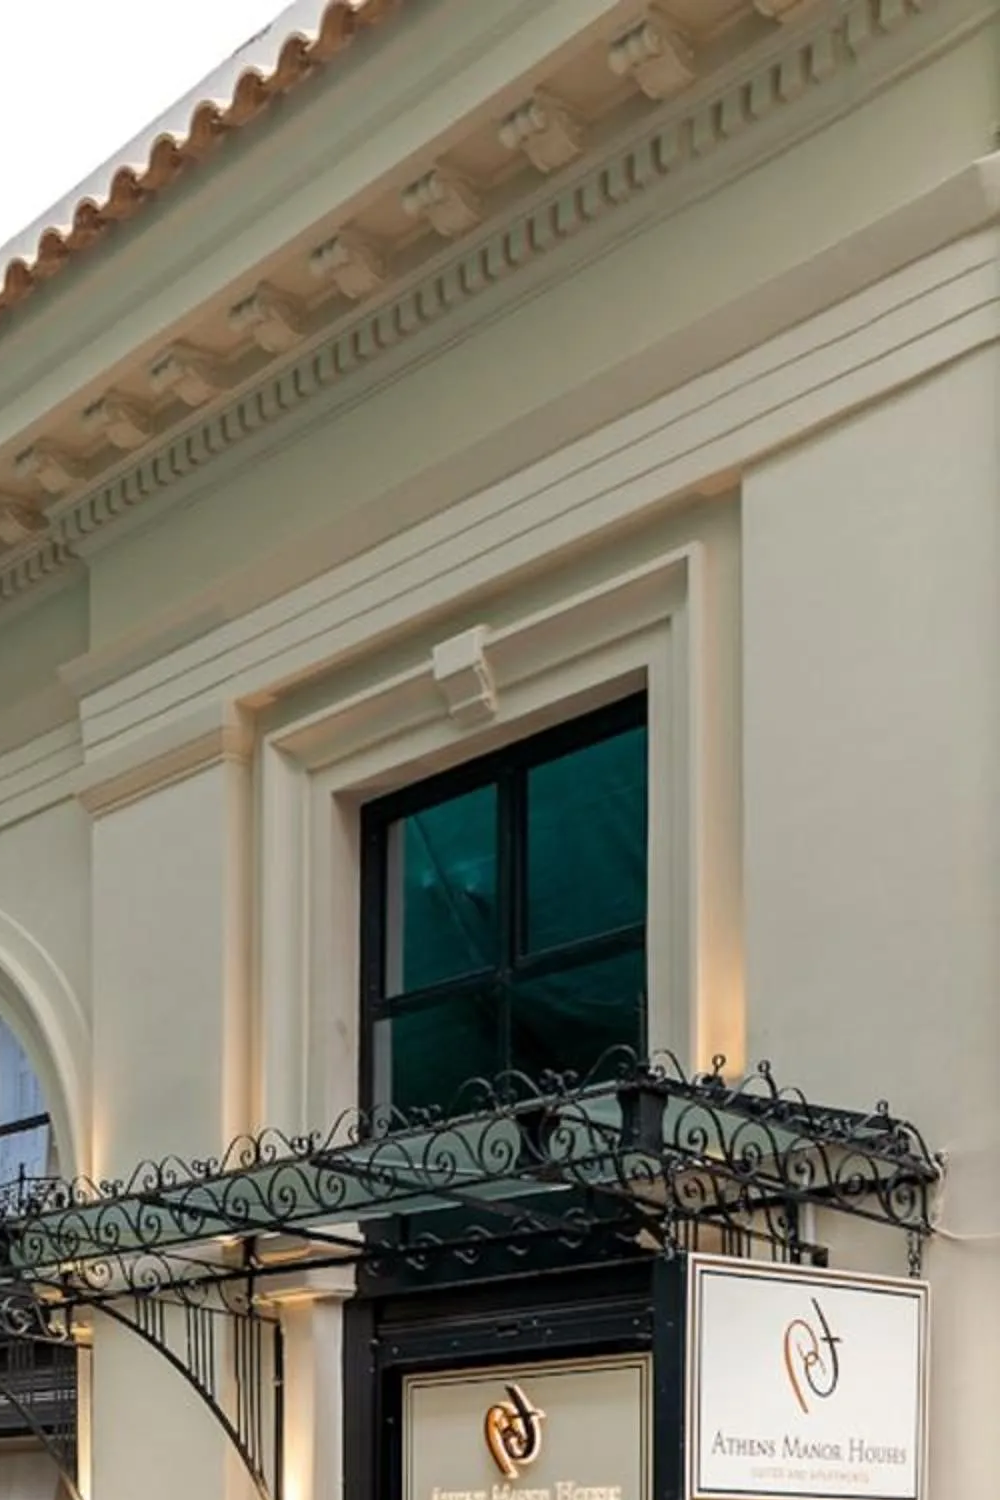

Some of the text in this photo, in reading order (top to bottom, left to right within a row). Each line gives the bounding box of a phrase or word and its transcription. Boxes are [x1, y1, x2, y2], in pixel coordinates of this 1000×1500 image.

[711, 1430, 907, 1465] ATHENS MANOR HOUSES
